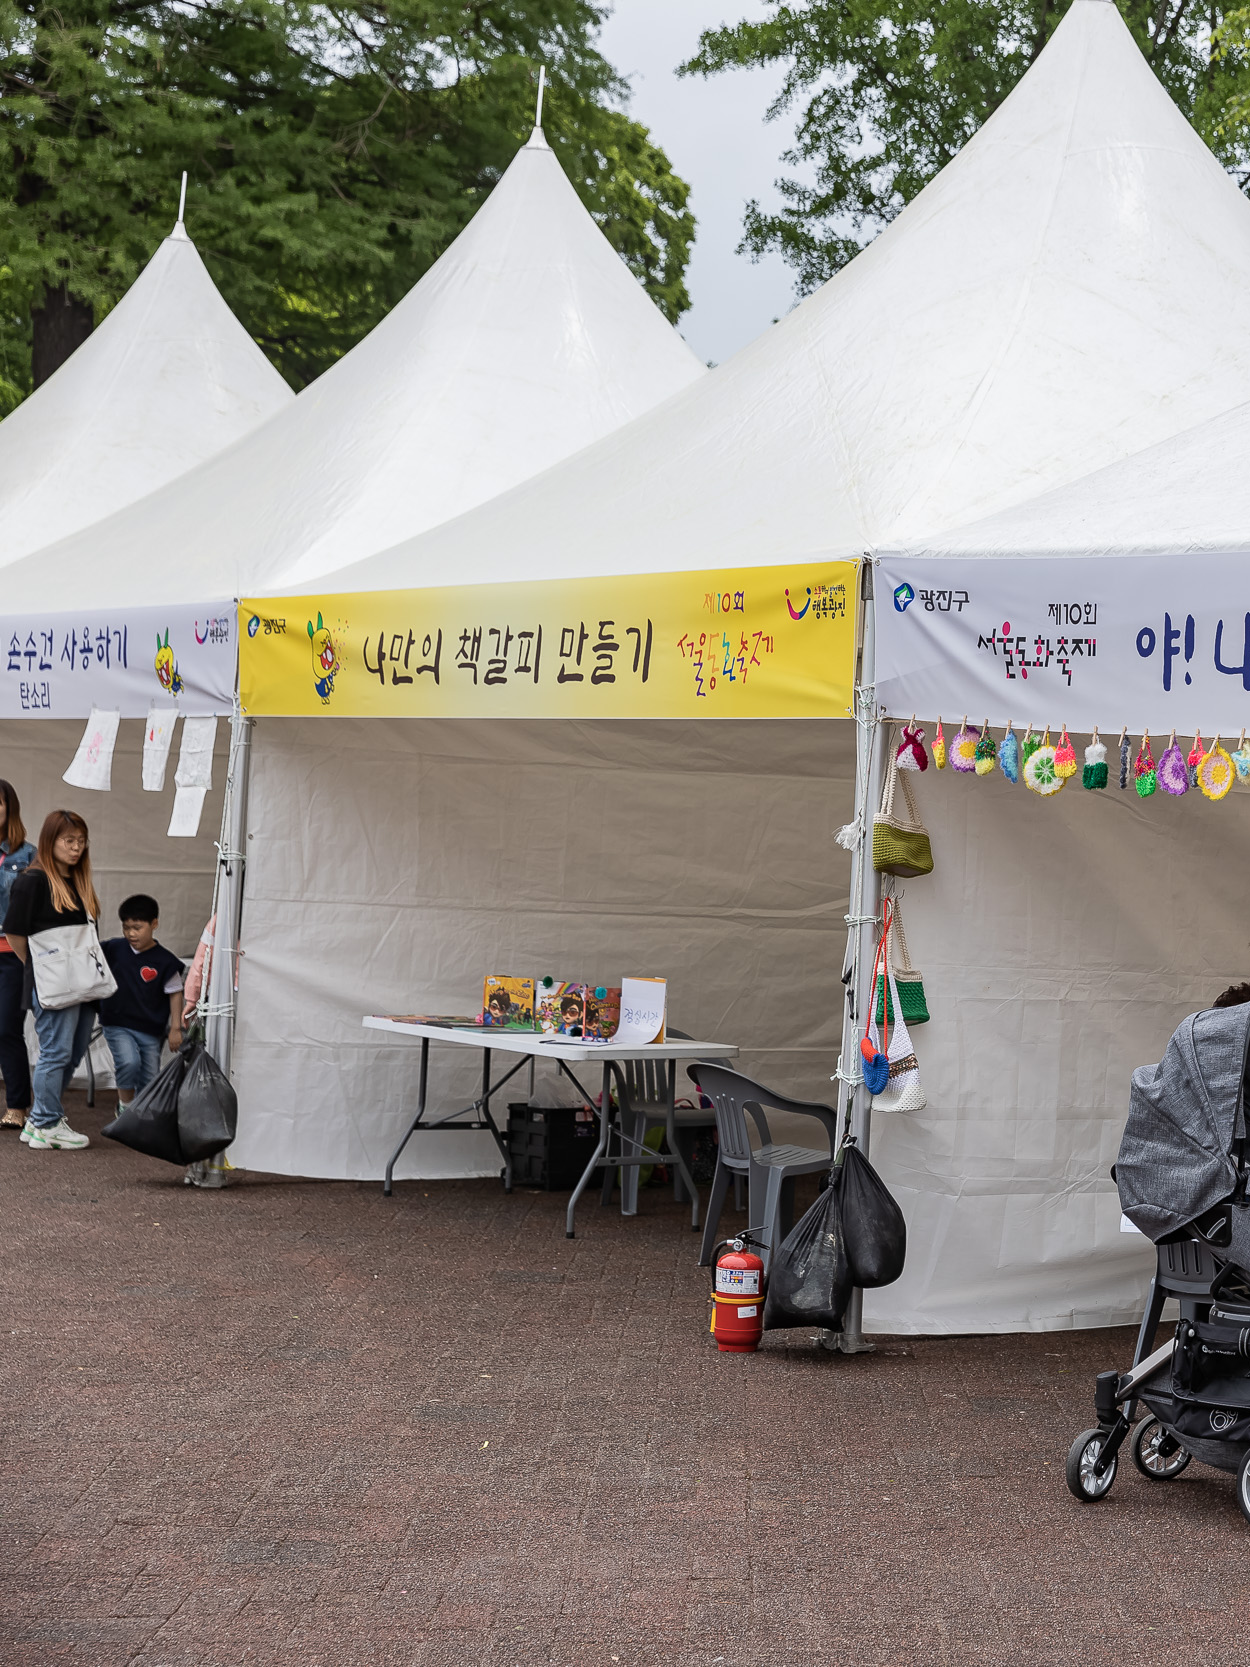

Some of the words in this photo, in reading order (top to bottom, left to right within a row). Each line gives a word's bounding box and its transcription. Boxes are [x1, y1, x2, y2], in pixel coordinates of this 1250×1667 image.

[703, 590, 745, 614] 제10회
[812, 597, 846, 619] 행복광진
[918, 588, 970, 612] 광진구
[1047, 602, 1097, 626] 제10회
[7, 628, 54, 672] 손수건
[60, 623, 128, 671] 사용하기
[363, 628, 443, 686] 나만의
[454, 624, 543, 687] 책갈피
[556, 617, 654, 687] 만들기
[676, 629, 775, 697] 서울동화축제
[976, 620, 1097, 687] 서울동화축제
[1135, 611, 1196, 692] 야!
[19, 681, 52, 710] 탄소리
